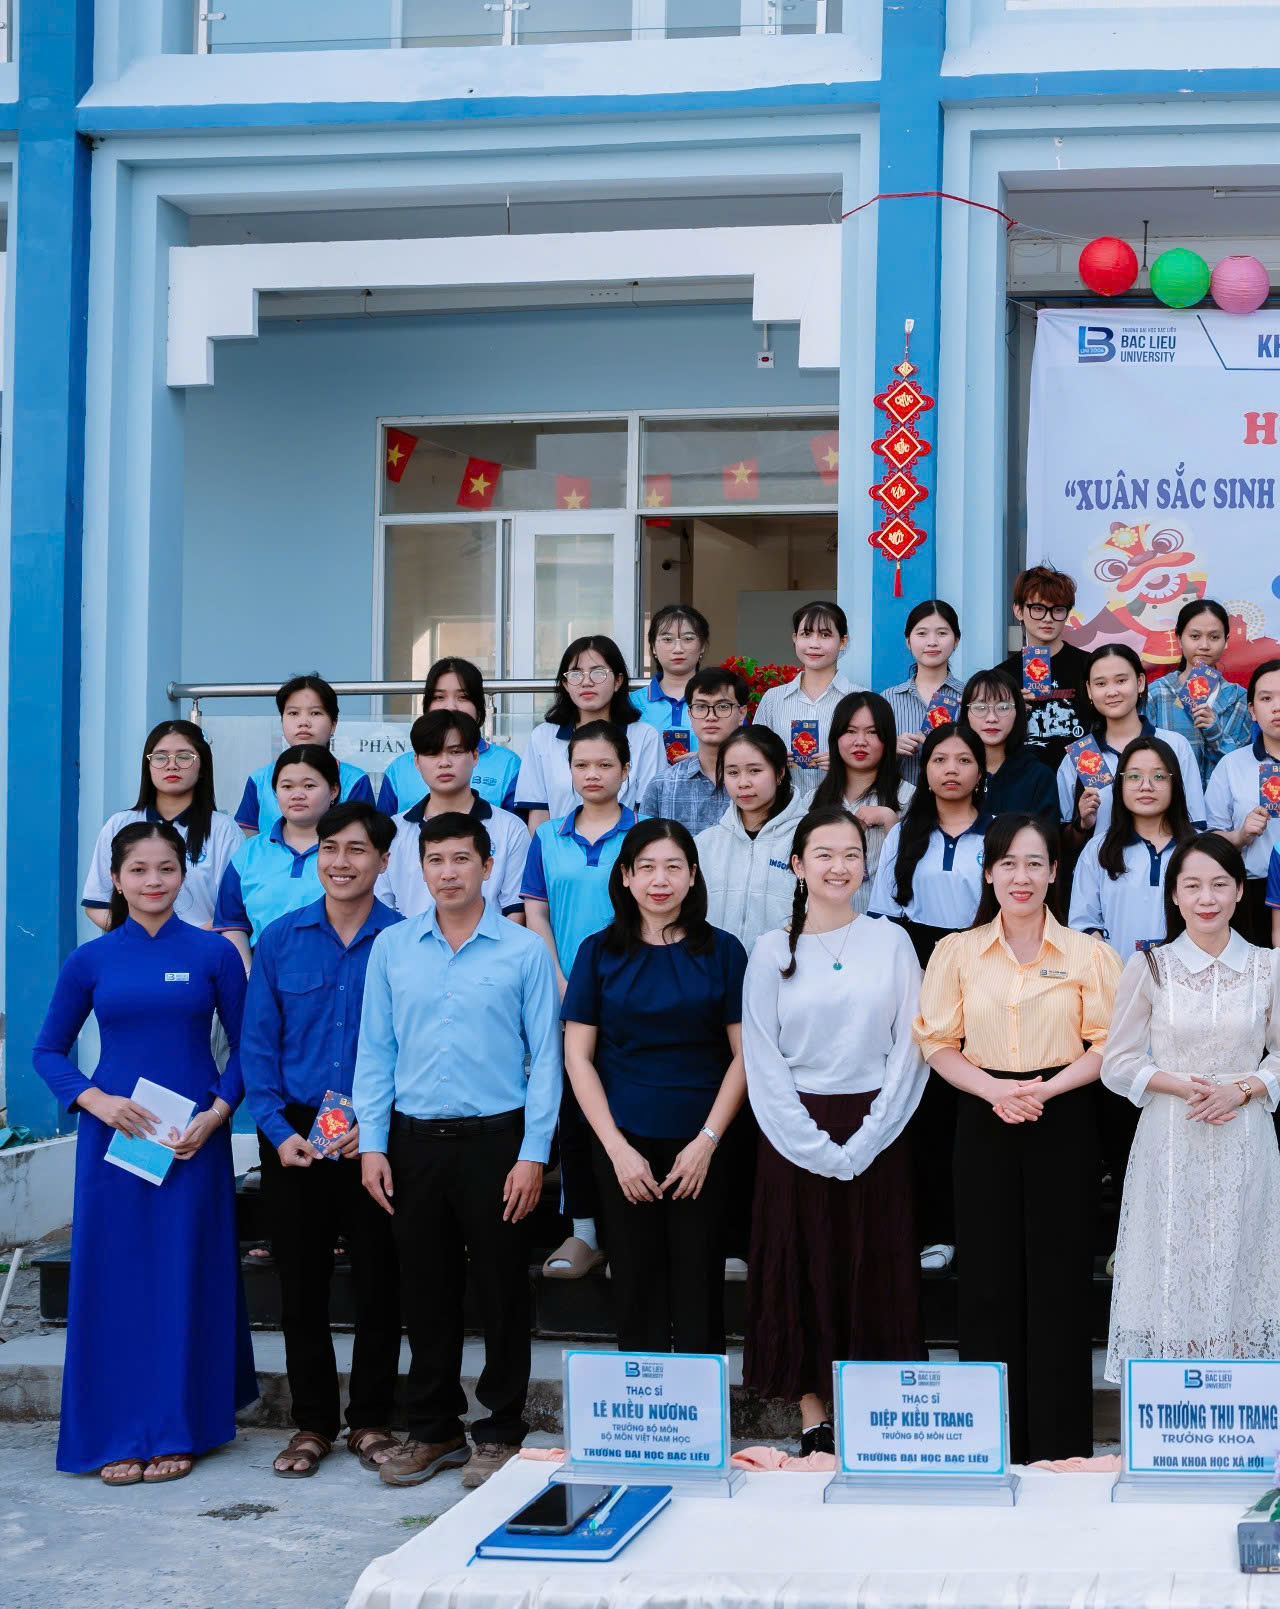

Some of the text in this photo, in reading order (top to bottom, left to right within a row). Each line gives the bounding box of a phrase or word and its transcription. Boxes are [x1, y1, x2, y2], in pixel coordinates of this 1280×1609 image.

[1121, 335, 1176, 349] BAC LIEU
[1120, 351, 1175, 362] UNIVERSITY
[1156, 461, 1206, 509] SẮC
[1213, 478, 1275, 509] SINH
[1027, 682, 1045, 690] 2026
[360, 736, 406, 753] PHẦN
[1205, 1374, 1232, 1382] BAC LIEU
[626, 1385, 662, 1397] THẠC SĨ
[902, 1392, 940, 1406] THẠC SĨ
[593, 1398, 698, 1420] LÊ KIỀU NƯƠNG
[870, 1408, 897, 1430] DIỆP
[933, 1412, 974, 1428] TRANG
[1138, 1404, 1154, 1429] TS
[1210, 1404, 1234, 1430] THU
[1238, 1405, 1278, 1430] TRANG
[612, 1424, 678, 1434] TRƯỞNG BỘ MÔN
[600, 1432, 690, 1444] BỘ MÔN VIỆT NAM HỌC
[882, 1430, 912, 1440] TRƯỞNG
[914, 1431, 924, 1442] BỘ
[926, 1431, 944, 1440] MÔN
[1161, 1432, 1255, 1444] TRƯỞNG KHOA
[584, 1448, 710, 1462] TRƯỜNG ĐẠI HỌC BẠC LIÊU
[857, 1452, 988, 1464] TRƯỜNG ĐẠI HỌC BẠC LIÊU
[1153, 1454, 1264, 1469] KHOA KHOA HỌC XÃ HỘI
